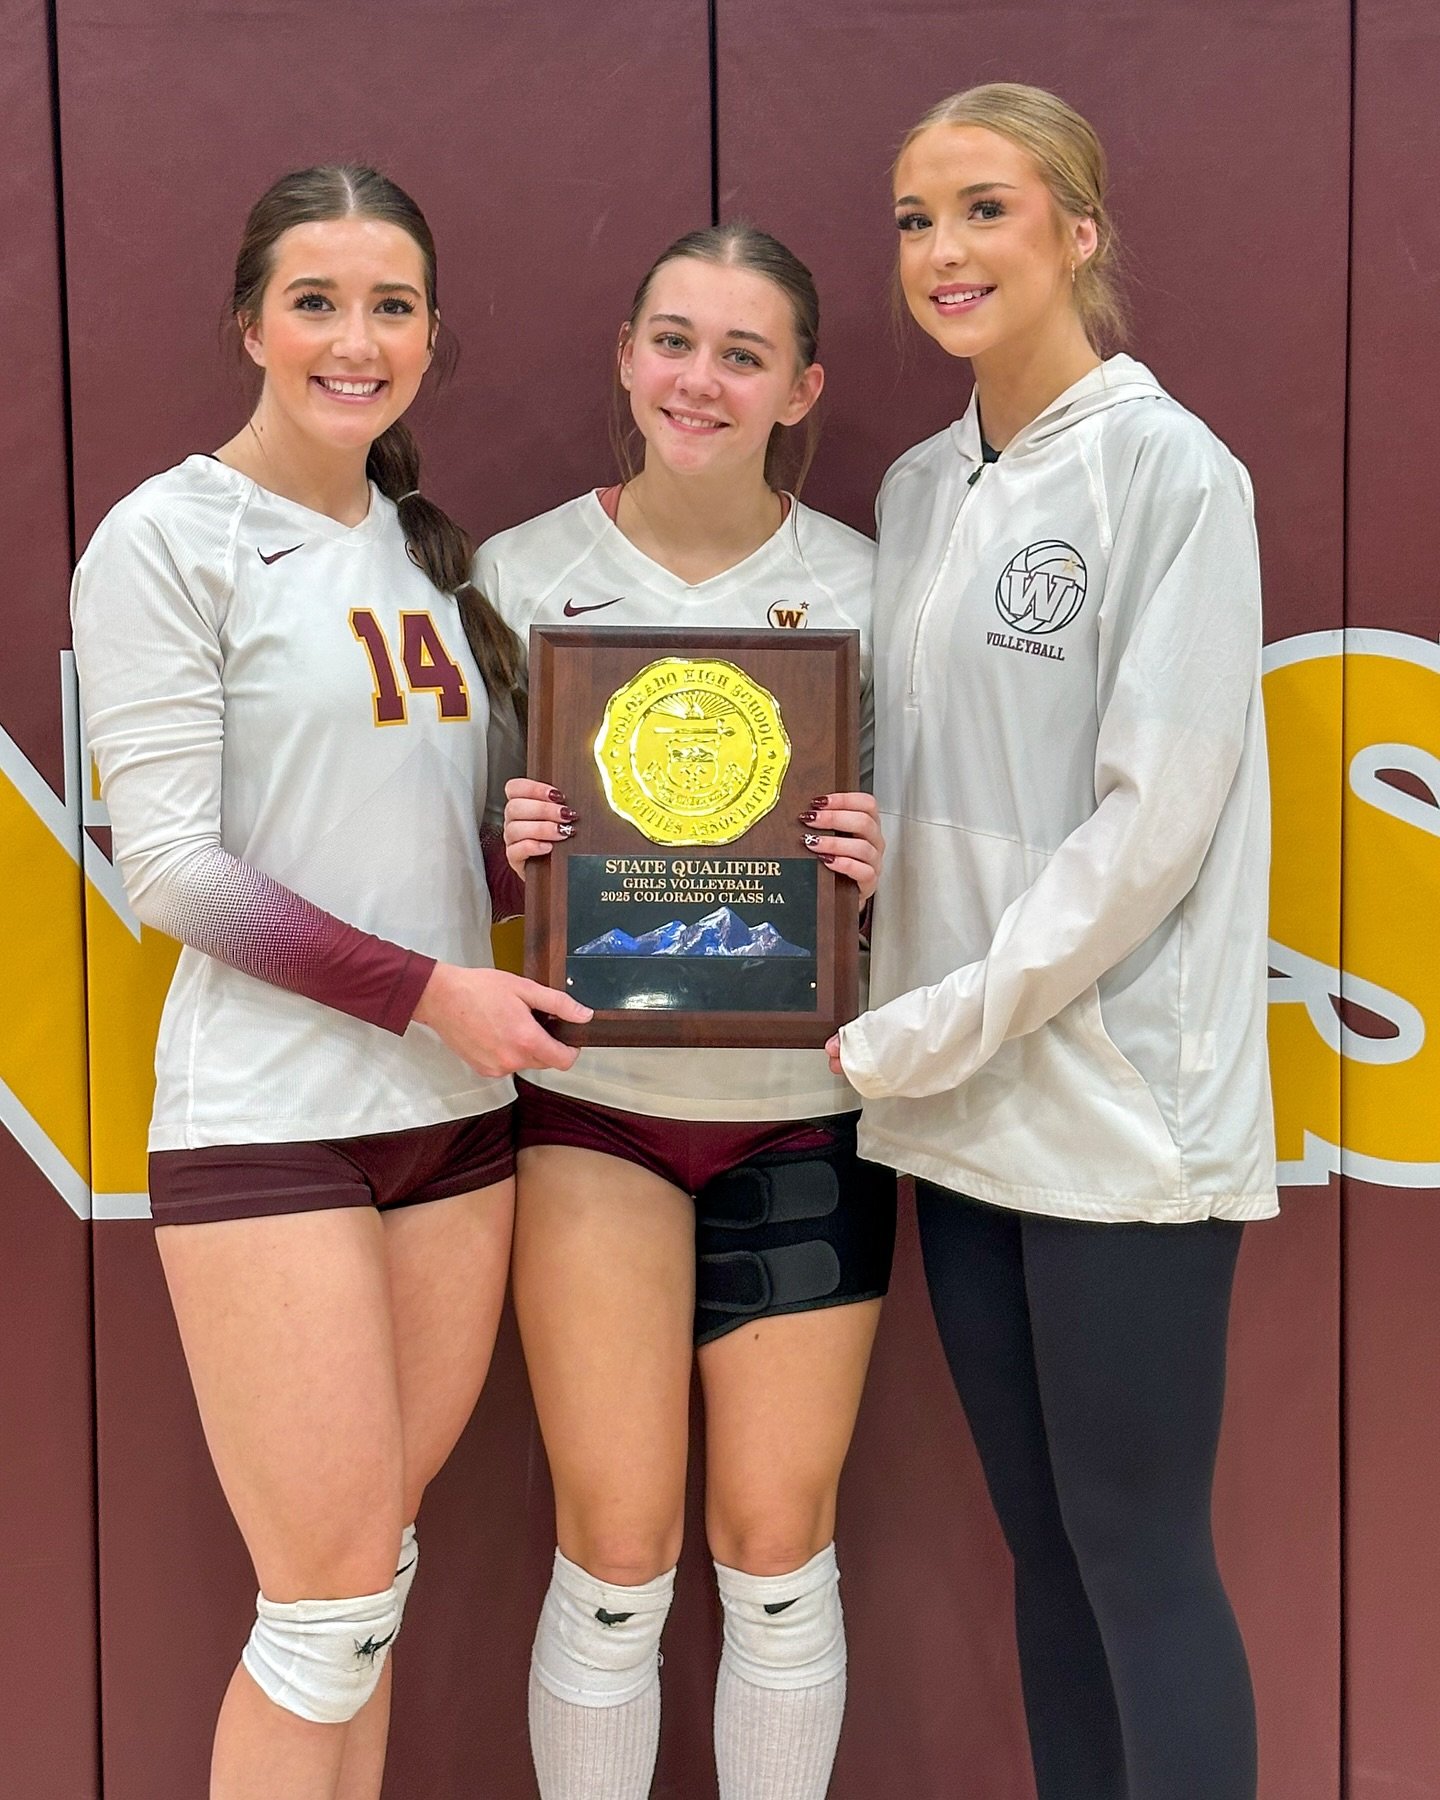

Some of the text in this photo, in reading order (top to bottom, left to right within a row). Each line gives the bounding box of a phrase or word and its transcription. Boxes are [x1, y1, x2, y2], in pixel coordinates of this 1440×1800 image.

[1006, 569, 1076, 623] W
[773, 608, 804, 629] W
[986, 631, 1066, 662] VOLLEYBALL
[349, 608, 471, 727] 14
[613, 668, 775, 746] COLORADO HIGH SCHOOL
[689, 764, 775, 836] ASSOCIATION
[605, 860, 782, 877] STATE QUALIFIER
[601, 891, 785, 905] 2025 COLORADO CLASS 4A
[623, 878, 764, 891] GIRLS VOLLEYBALL
